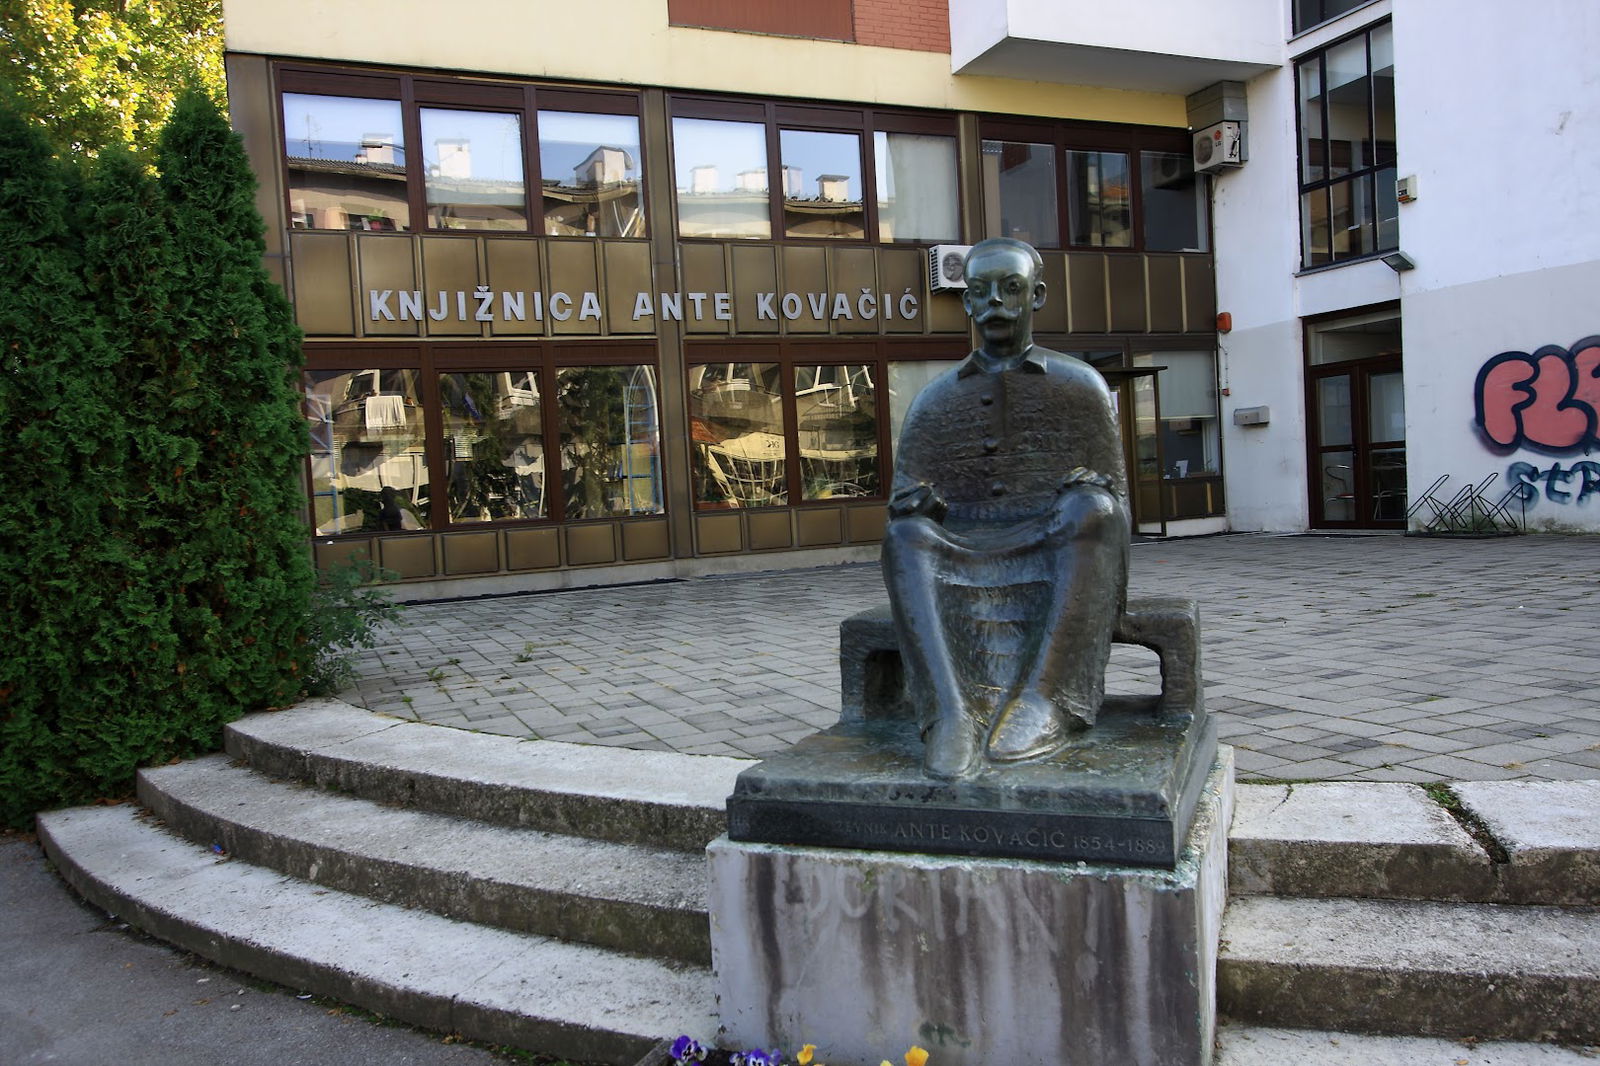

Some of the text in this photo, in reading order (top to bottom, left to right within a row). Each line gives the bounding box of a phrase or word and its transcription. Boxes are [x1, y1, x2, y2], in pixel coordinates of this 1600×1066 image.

[369, 285, 918, 321] KNJIŽNICA ANTE KOVAČIĆ
[895, 823, 951, 840] ANTE
[959, 825, 1065, 848] KOVAČIĆ
[1073, 834, 1166, 854] 1854-1889
